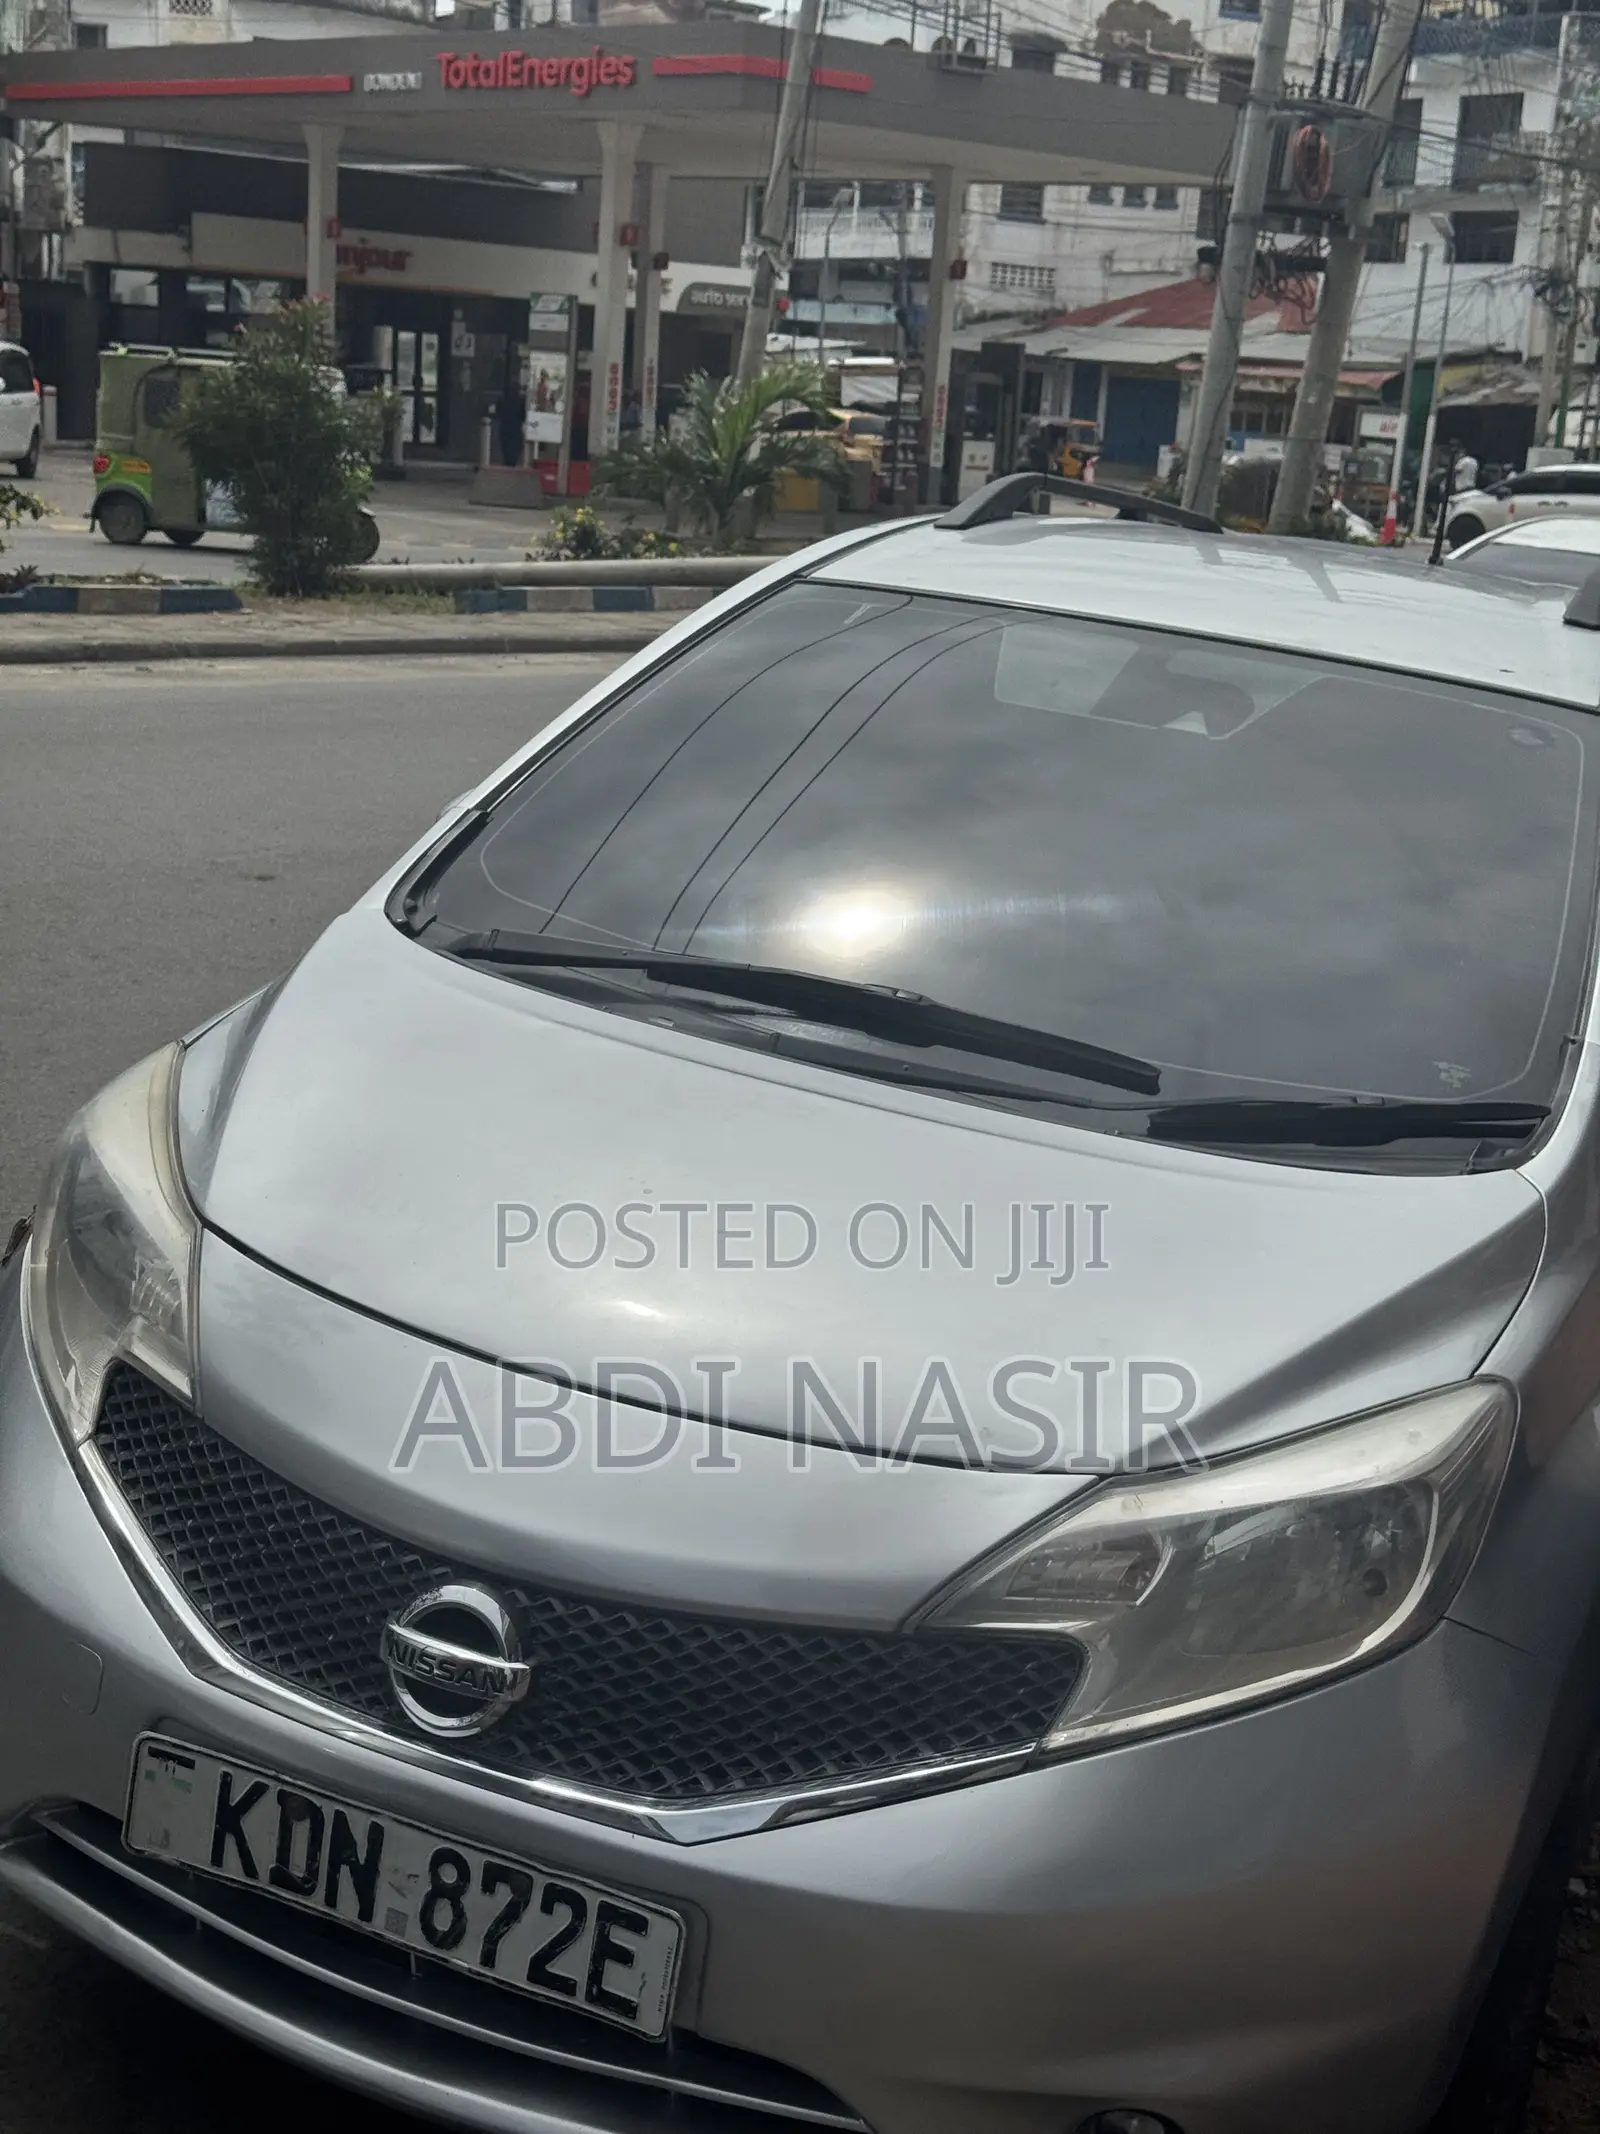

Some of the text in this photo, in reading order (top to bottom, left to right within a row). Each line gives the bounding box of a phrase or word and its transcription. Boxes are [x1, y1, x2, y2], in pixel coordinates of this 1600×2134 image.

[436, 46, 635, 97] TotalEnergies
[387, 1635, 520, 1697] NISSAN
[210, 1769, 385, 1923] KDN
[418, 1845, 652, 2021] 872E
